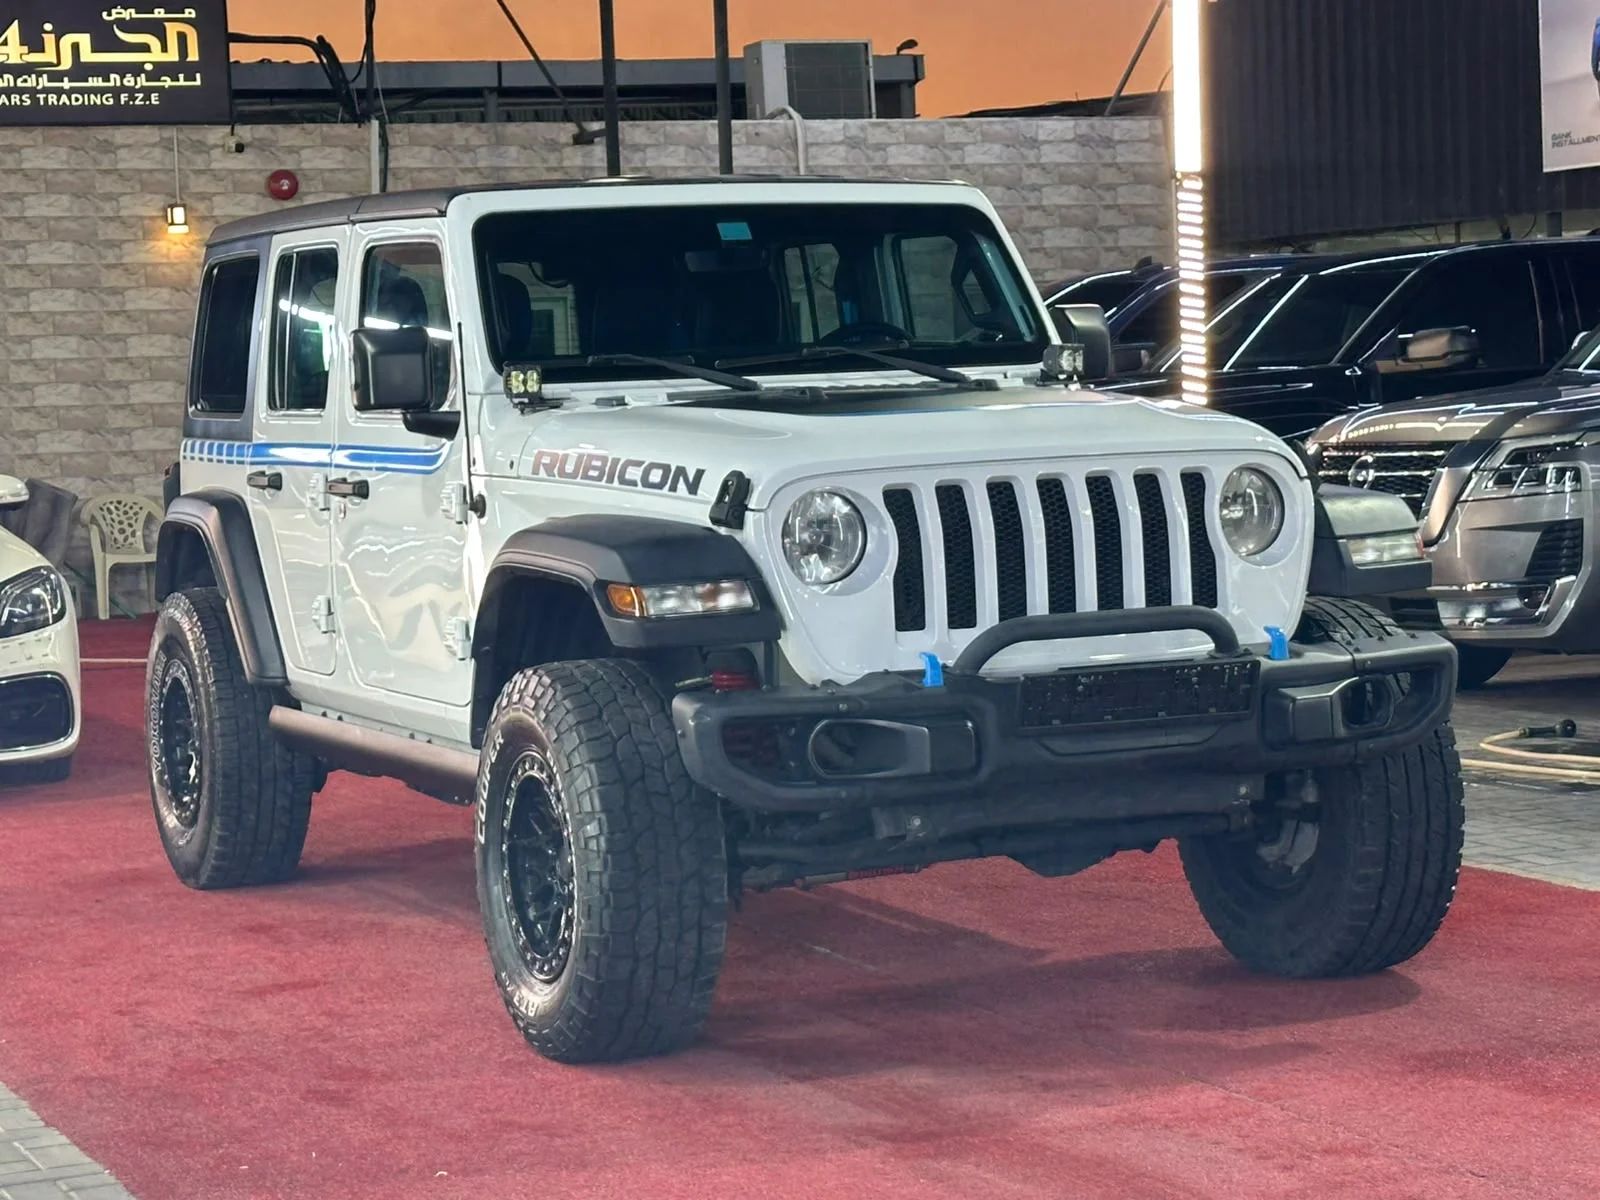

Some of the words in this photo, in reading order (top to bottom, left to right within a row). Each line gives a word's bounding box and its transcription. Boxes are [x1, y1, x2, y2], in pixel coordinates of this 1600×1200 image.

[102, 6, 196, 20] معرض
[16, 73, 121, 90] السيارات
[123, 73, 201, 88] لتجارة
[37, 93, 114, 106] TRADING
[120, 92, 160, 105] F.Z.E
[1551, 131, 1572, 141] BANK
[532, 450, 706, 496] RUBICON
[477, 729, 504, 845] COOPER
